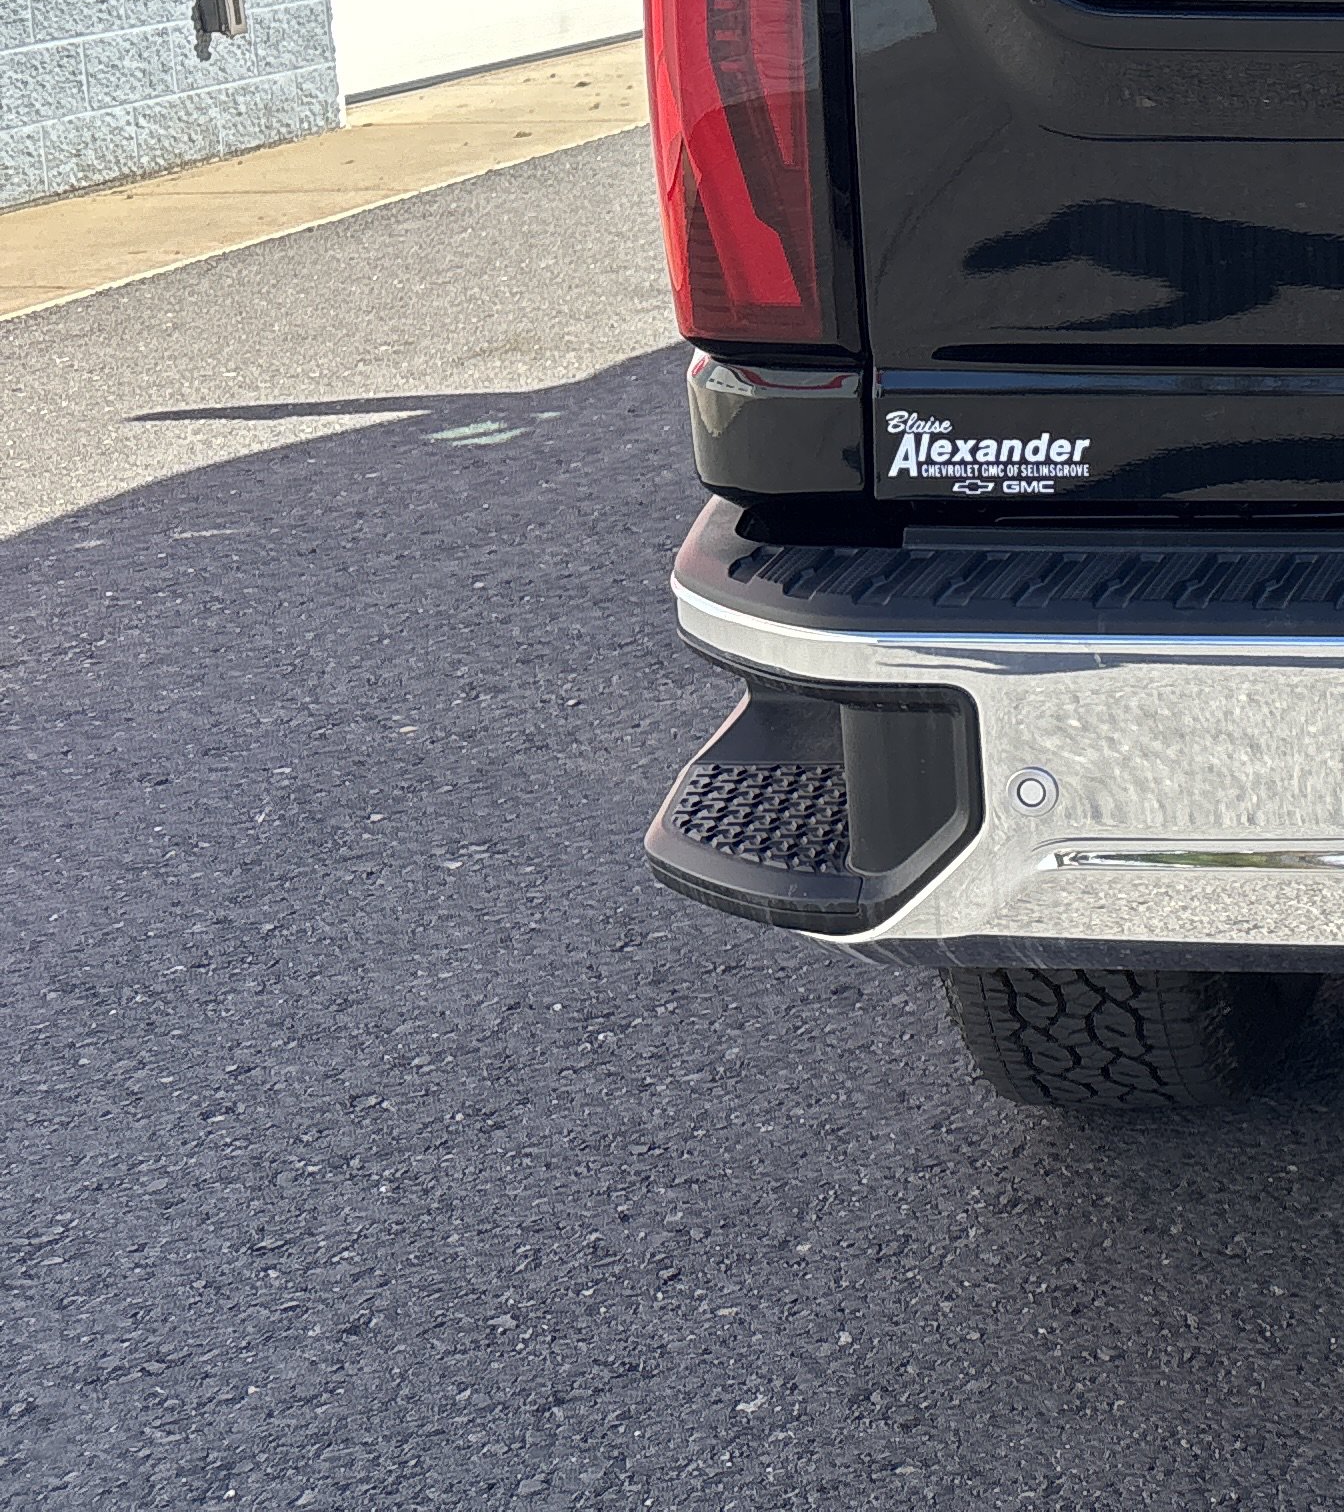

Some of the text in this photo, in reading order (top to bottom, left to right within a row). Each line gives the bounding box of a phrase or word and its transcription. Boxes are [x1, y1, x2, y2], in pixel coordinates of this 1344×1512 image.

[885, 410, 953, 434] Blaise
[887, 432, 1092, 478] Alexander
[921, 464, 1090, 477] CHEVROLET GMC OF SELINSGROVE
[1002, 480, 1055, 494] GMC
